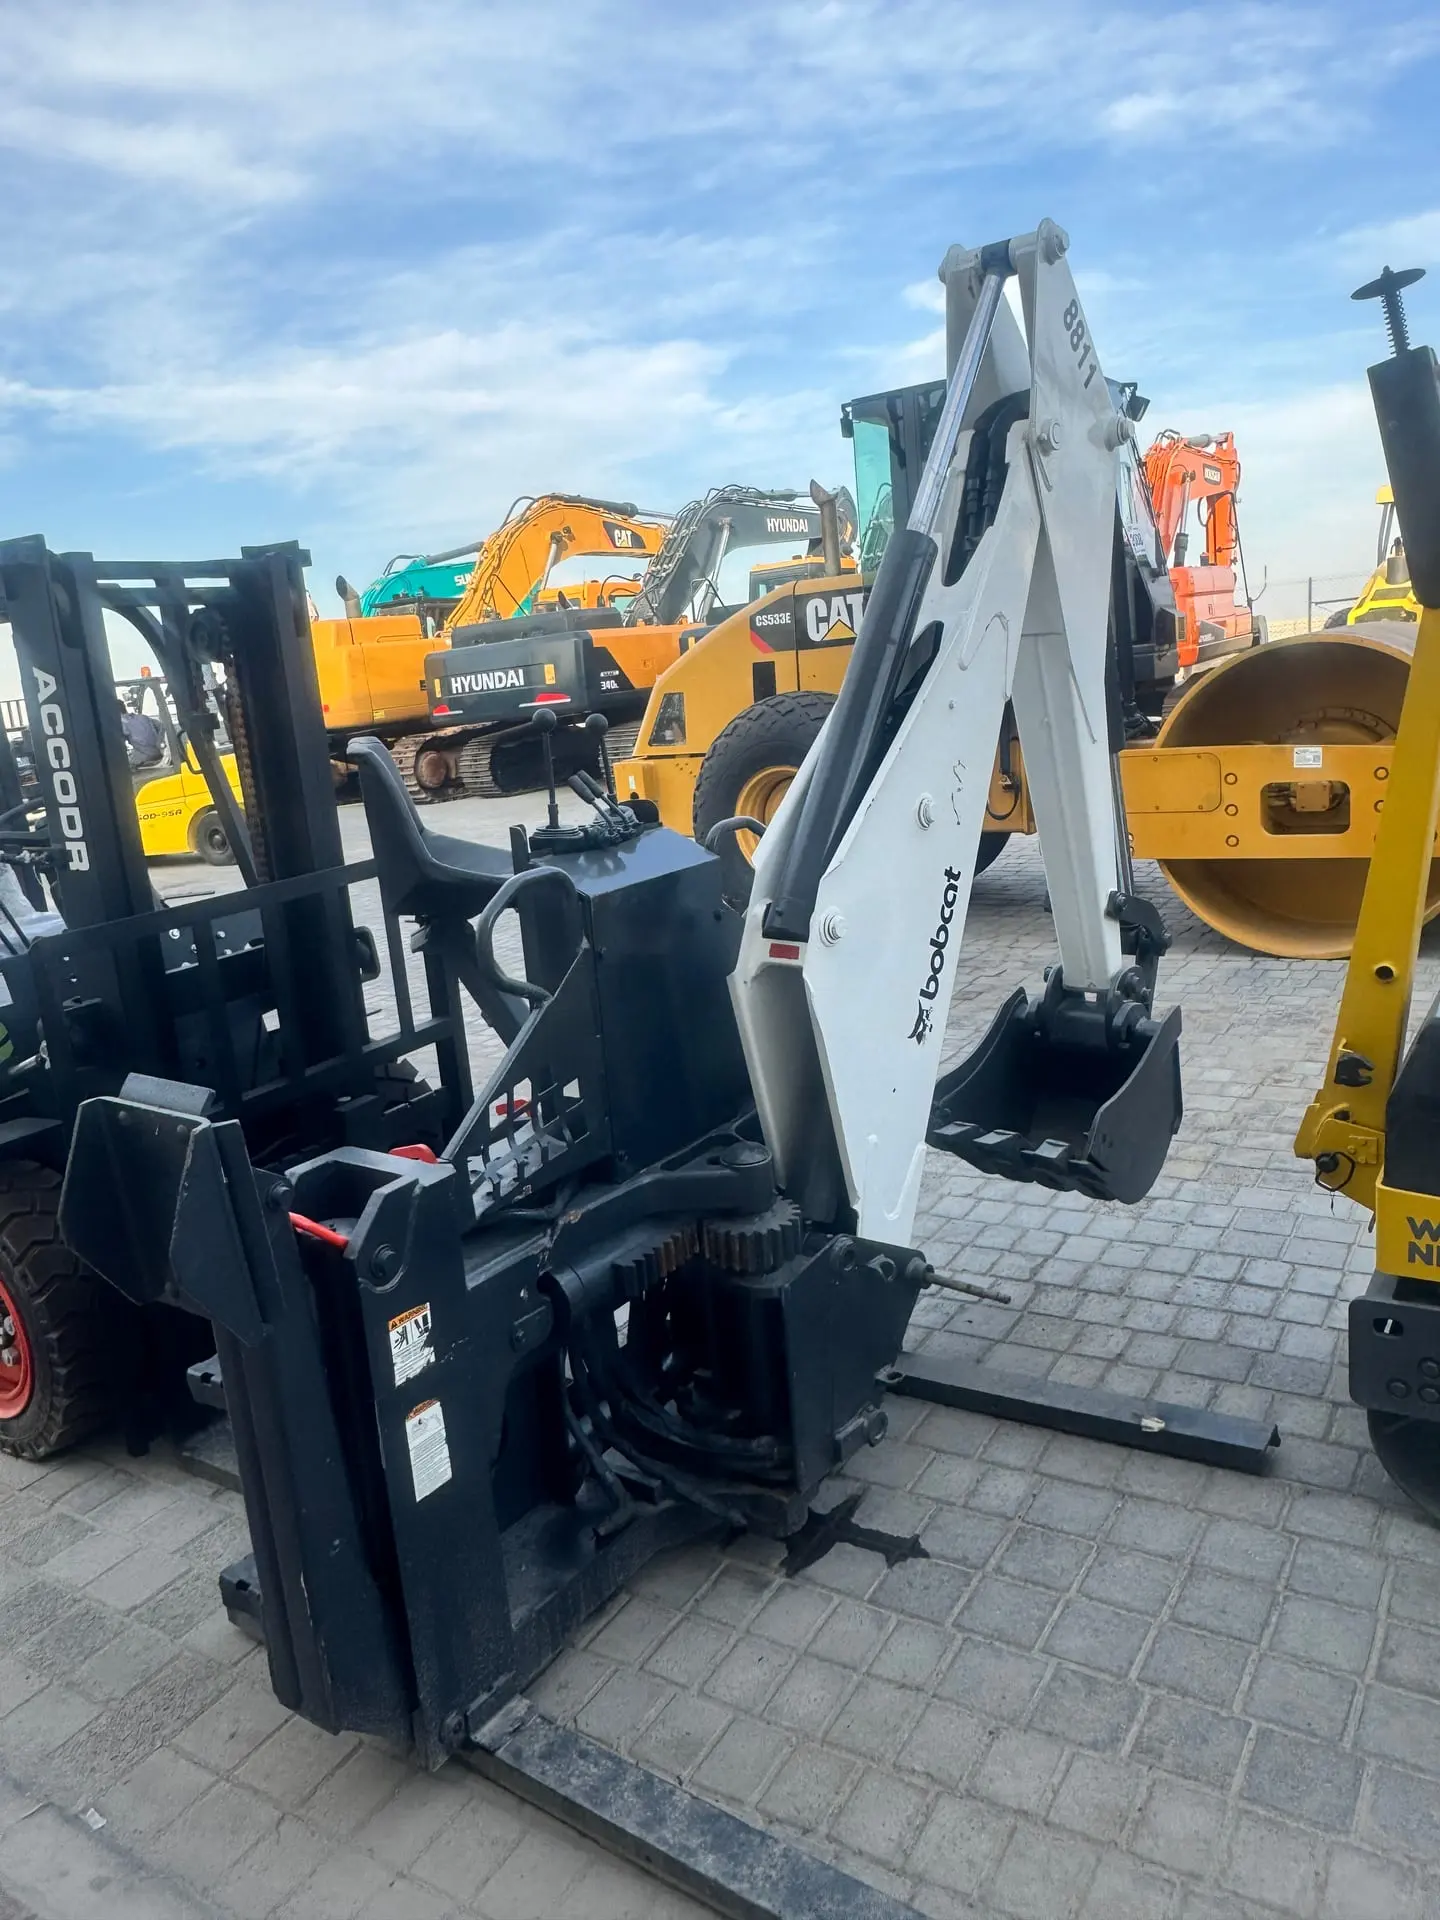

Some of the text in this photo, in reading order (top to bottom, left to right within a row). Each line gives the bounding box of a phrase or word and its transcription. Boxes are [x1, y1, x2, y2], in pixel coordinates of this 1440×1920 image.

[1063, 298, 1097, 389] 8811
[614, 529, 632, 547] CAT
[766, 518, 809, 532] HYUNDAI
[755, 612, 791, 626] CS533E
[806, 593, 864, 642] CAT
[450, 669, 525, 694] HYUNDAI
[32, 666, 90, 871] ACCODR
[919, 865, 962, 1001] bobcat
